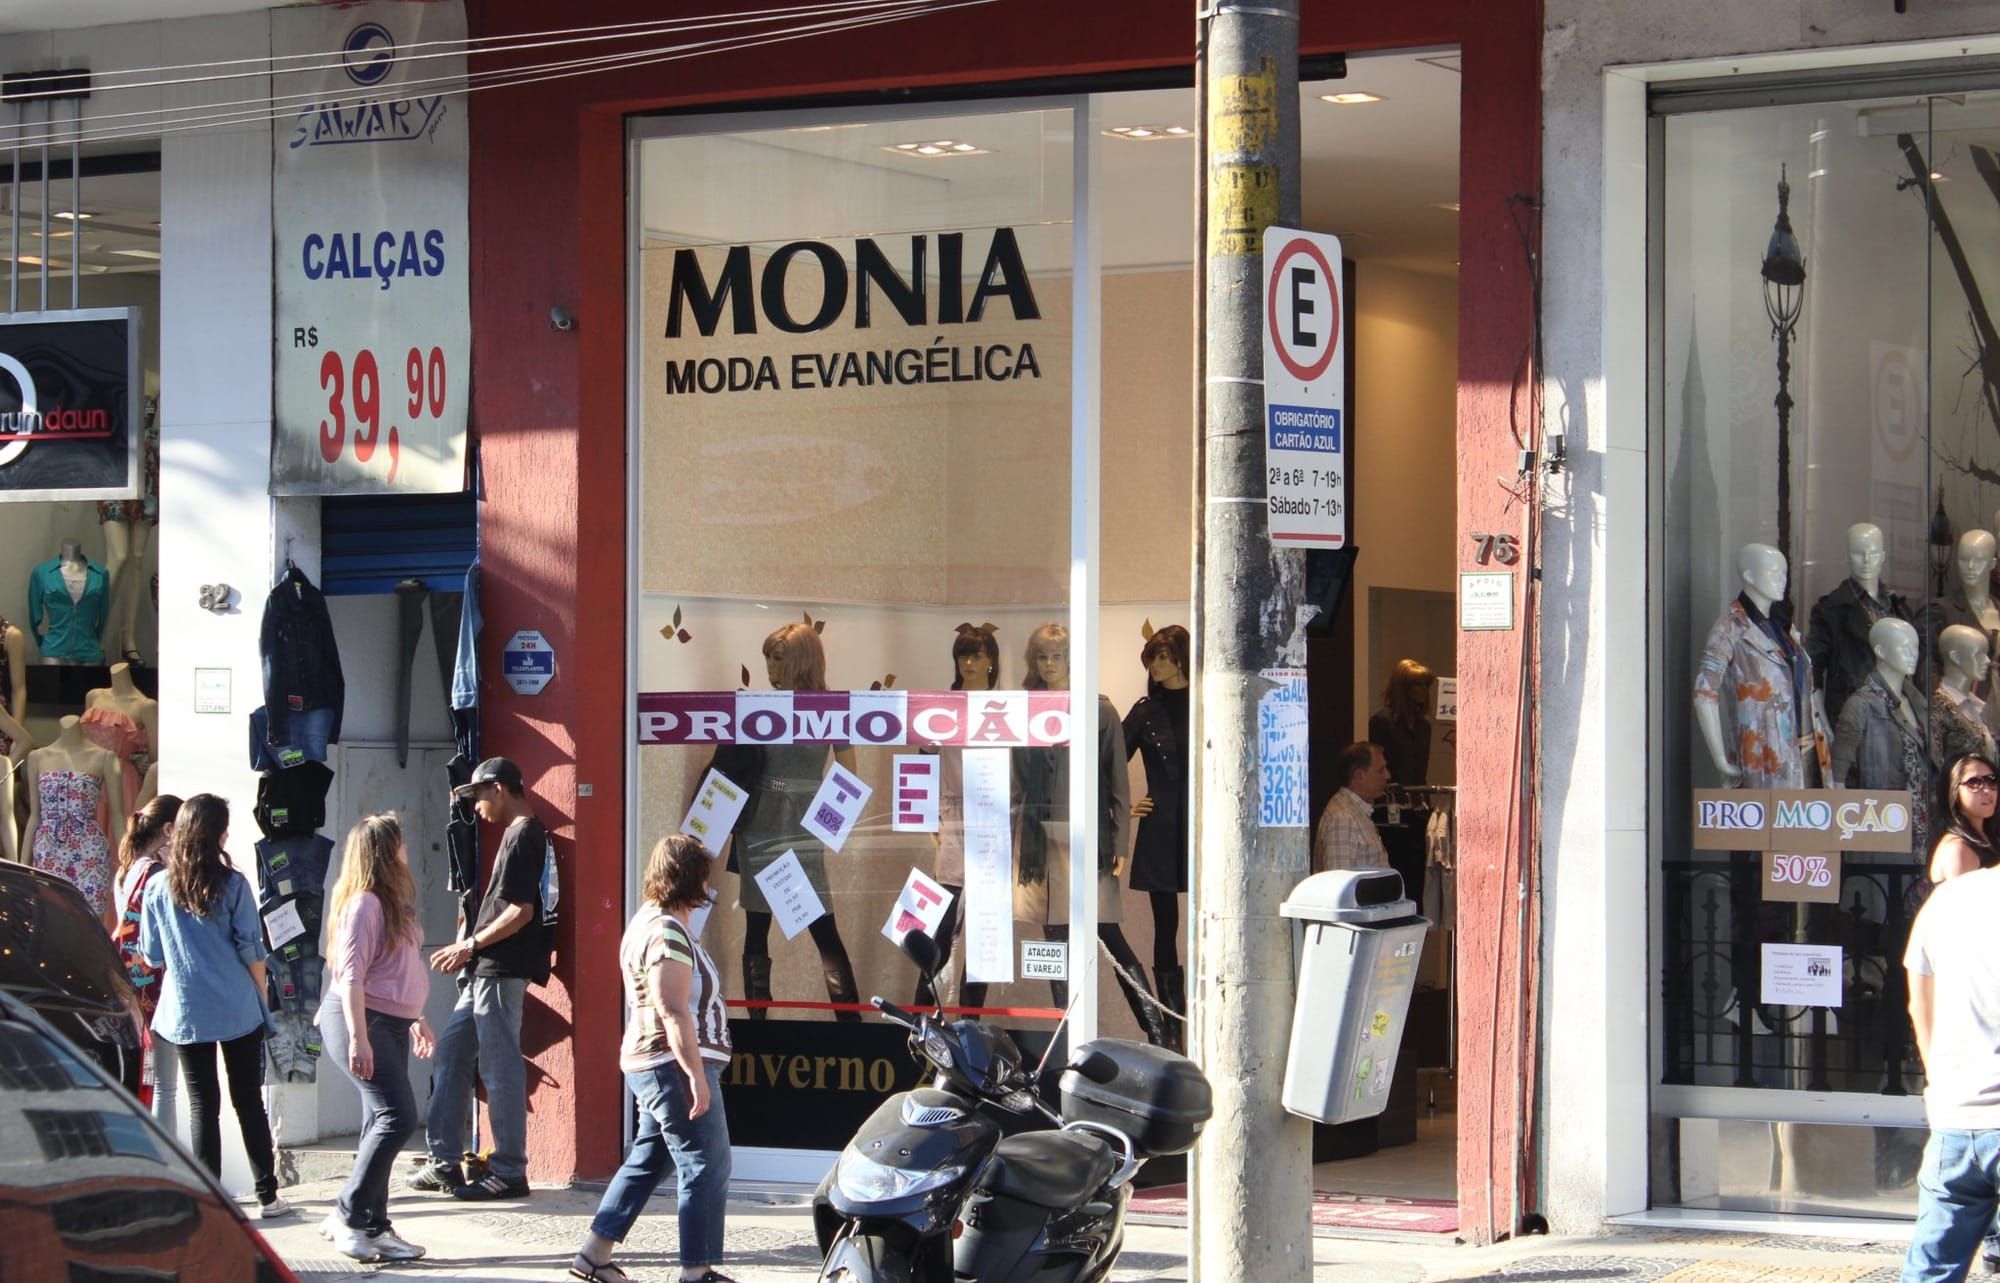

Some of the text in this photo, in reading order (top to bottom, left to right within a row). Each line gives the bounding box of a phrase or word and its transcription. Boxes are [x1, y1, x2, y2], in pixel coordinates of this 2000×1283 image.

[289, 95, 442, 149] SAWARY
[302, 229, 446, 291] CALÇAS
[665, 228, 1042, 339] MONIA
[1291, 267, 1317, 347] E
[294, 326, 319, 348] R$
[665, 335, 1043, 395] MODA EVANGÉLICA
[1274, 410, 1335, 430] OBRIGATÓRIO
[1275, 430, 1336, 450] CARTÃO AZUL
[1270, 496, 1311, 516] Sábado
[1471, 533, 1514, 565] 76
[639, 700, 1071, 747] PROMOÇÃO
[817, 808, 842, 832] 40%
[1771, 854, 1831, 887] 50%
[1026, 963, 1062, 974] E VAREJO
[1028, 947, 1061, 958] ATACADO
[719, 1052, 895, 1092] nverno
